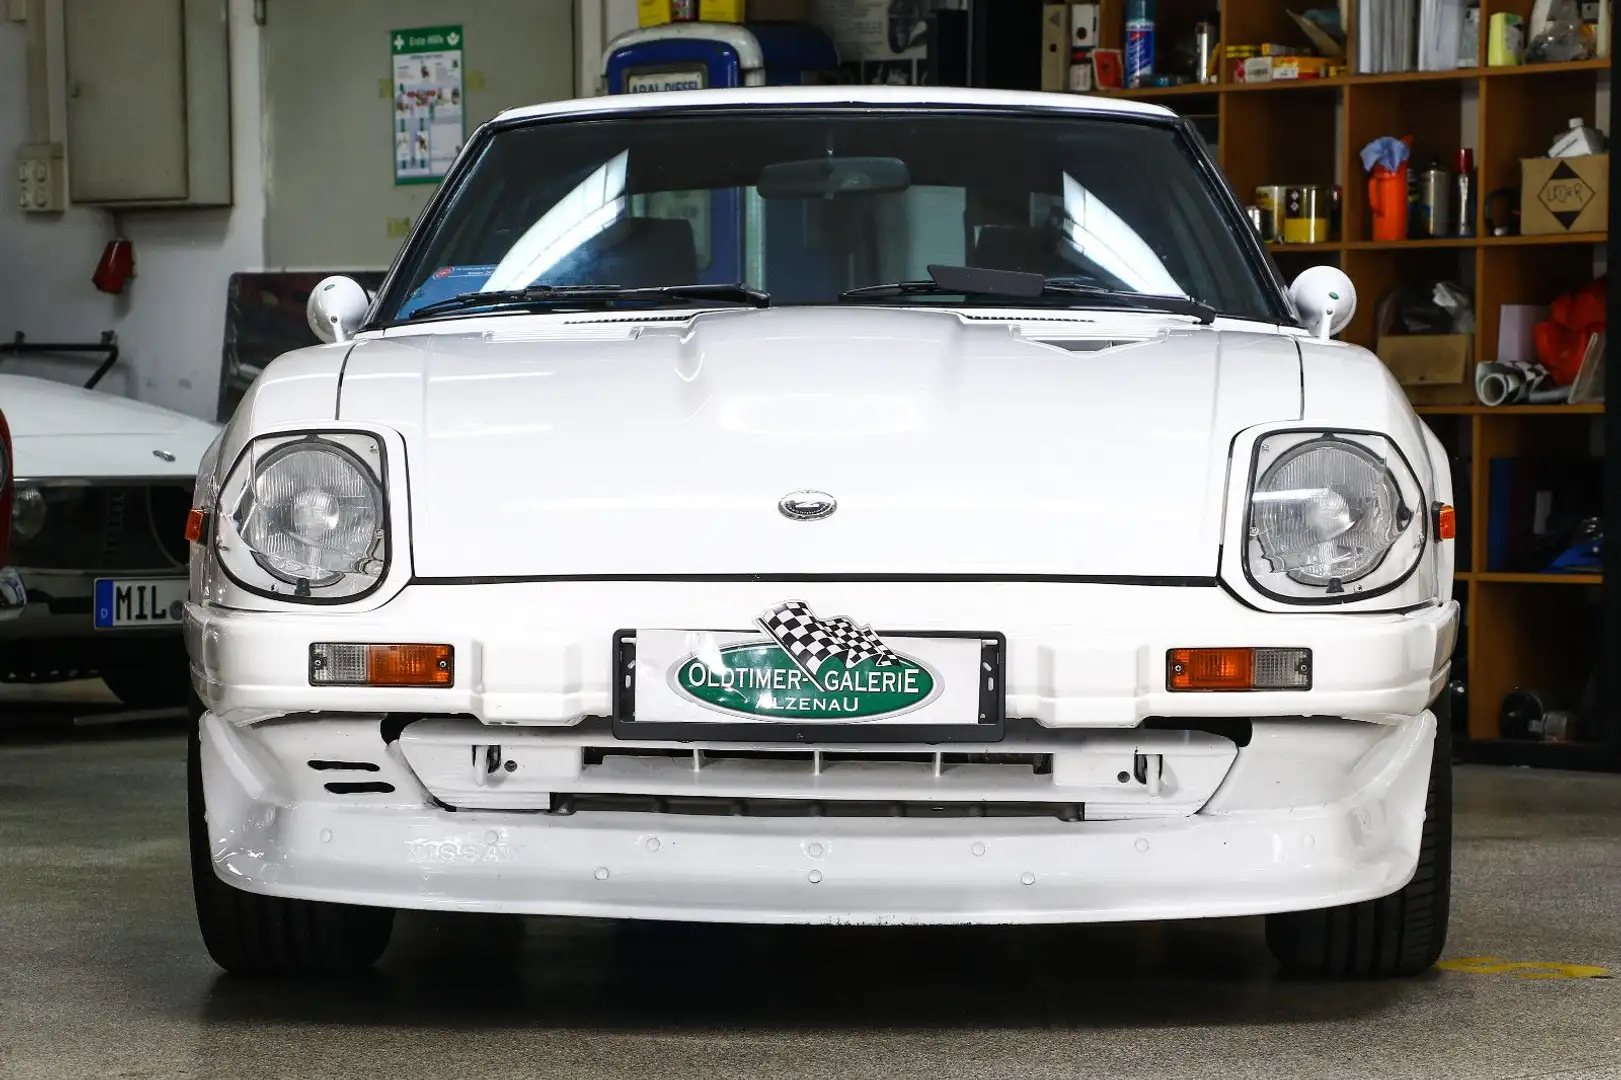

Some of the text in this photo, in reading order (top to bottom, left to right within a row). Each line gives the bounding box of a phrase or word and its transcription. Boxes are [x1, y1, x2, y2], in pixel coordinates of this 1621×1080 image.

[1545, 182, 1584, 203] LEDER
[115, 585, 167, 621] MIL
[823, 668, 920, 694] GALERIE
